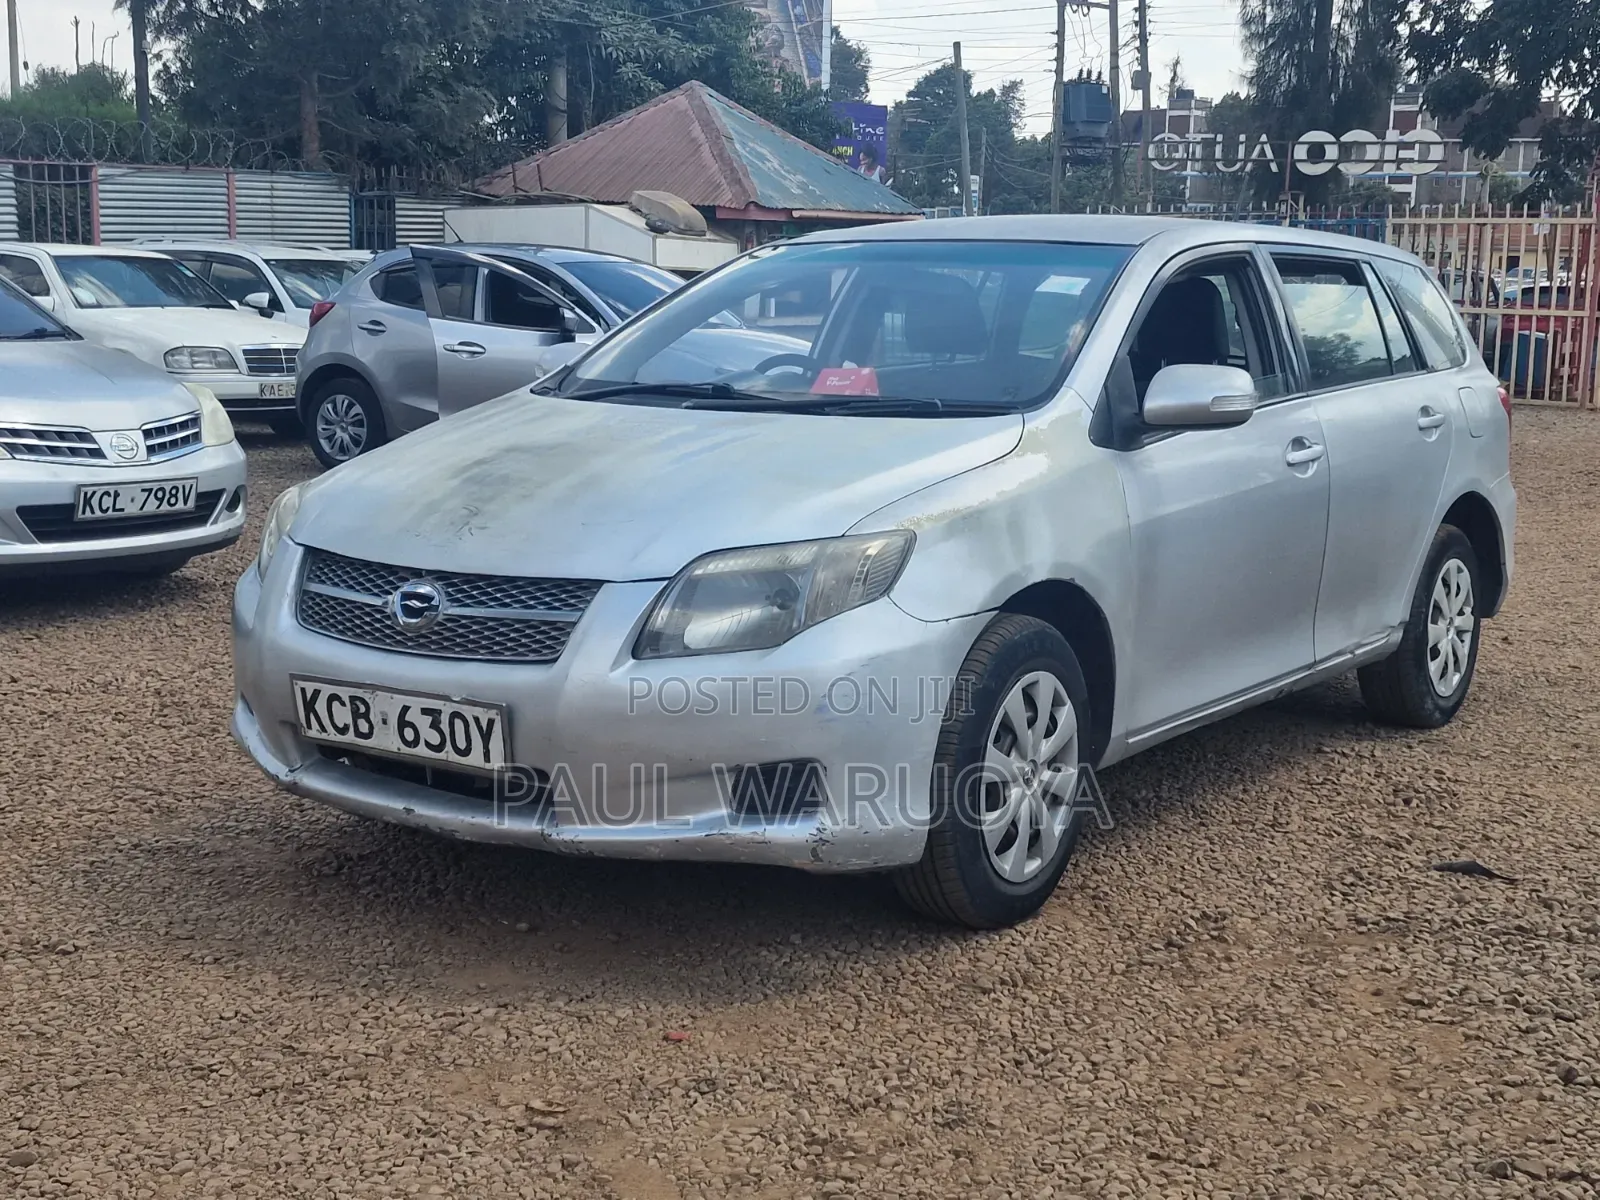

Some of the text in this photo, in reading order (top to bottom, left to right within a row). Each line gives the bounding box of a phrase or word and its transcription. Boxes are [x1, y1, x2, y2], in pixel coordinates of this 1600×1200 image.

[260, 383, 284, 397] KAE
[81, 483, 194, 515] KCL 798V
[300, 686, 496, 764] KCB 630Y
